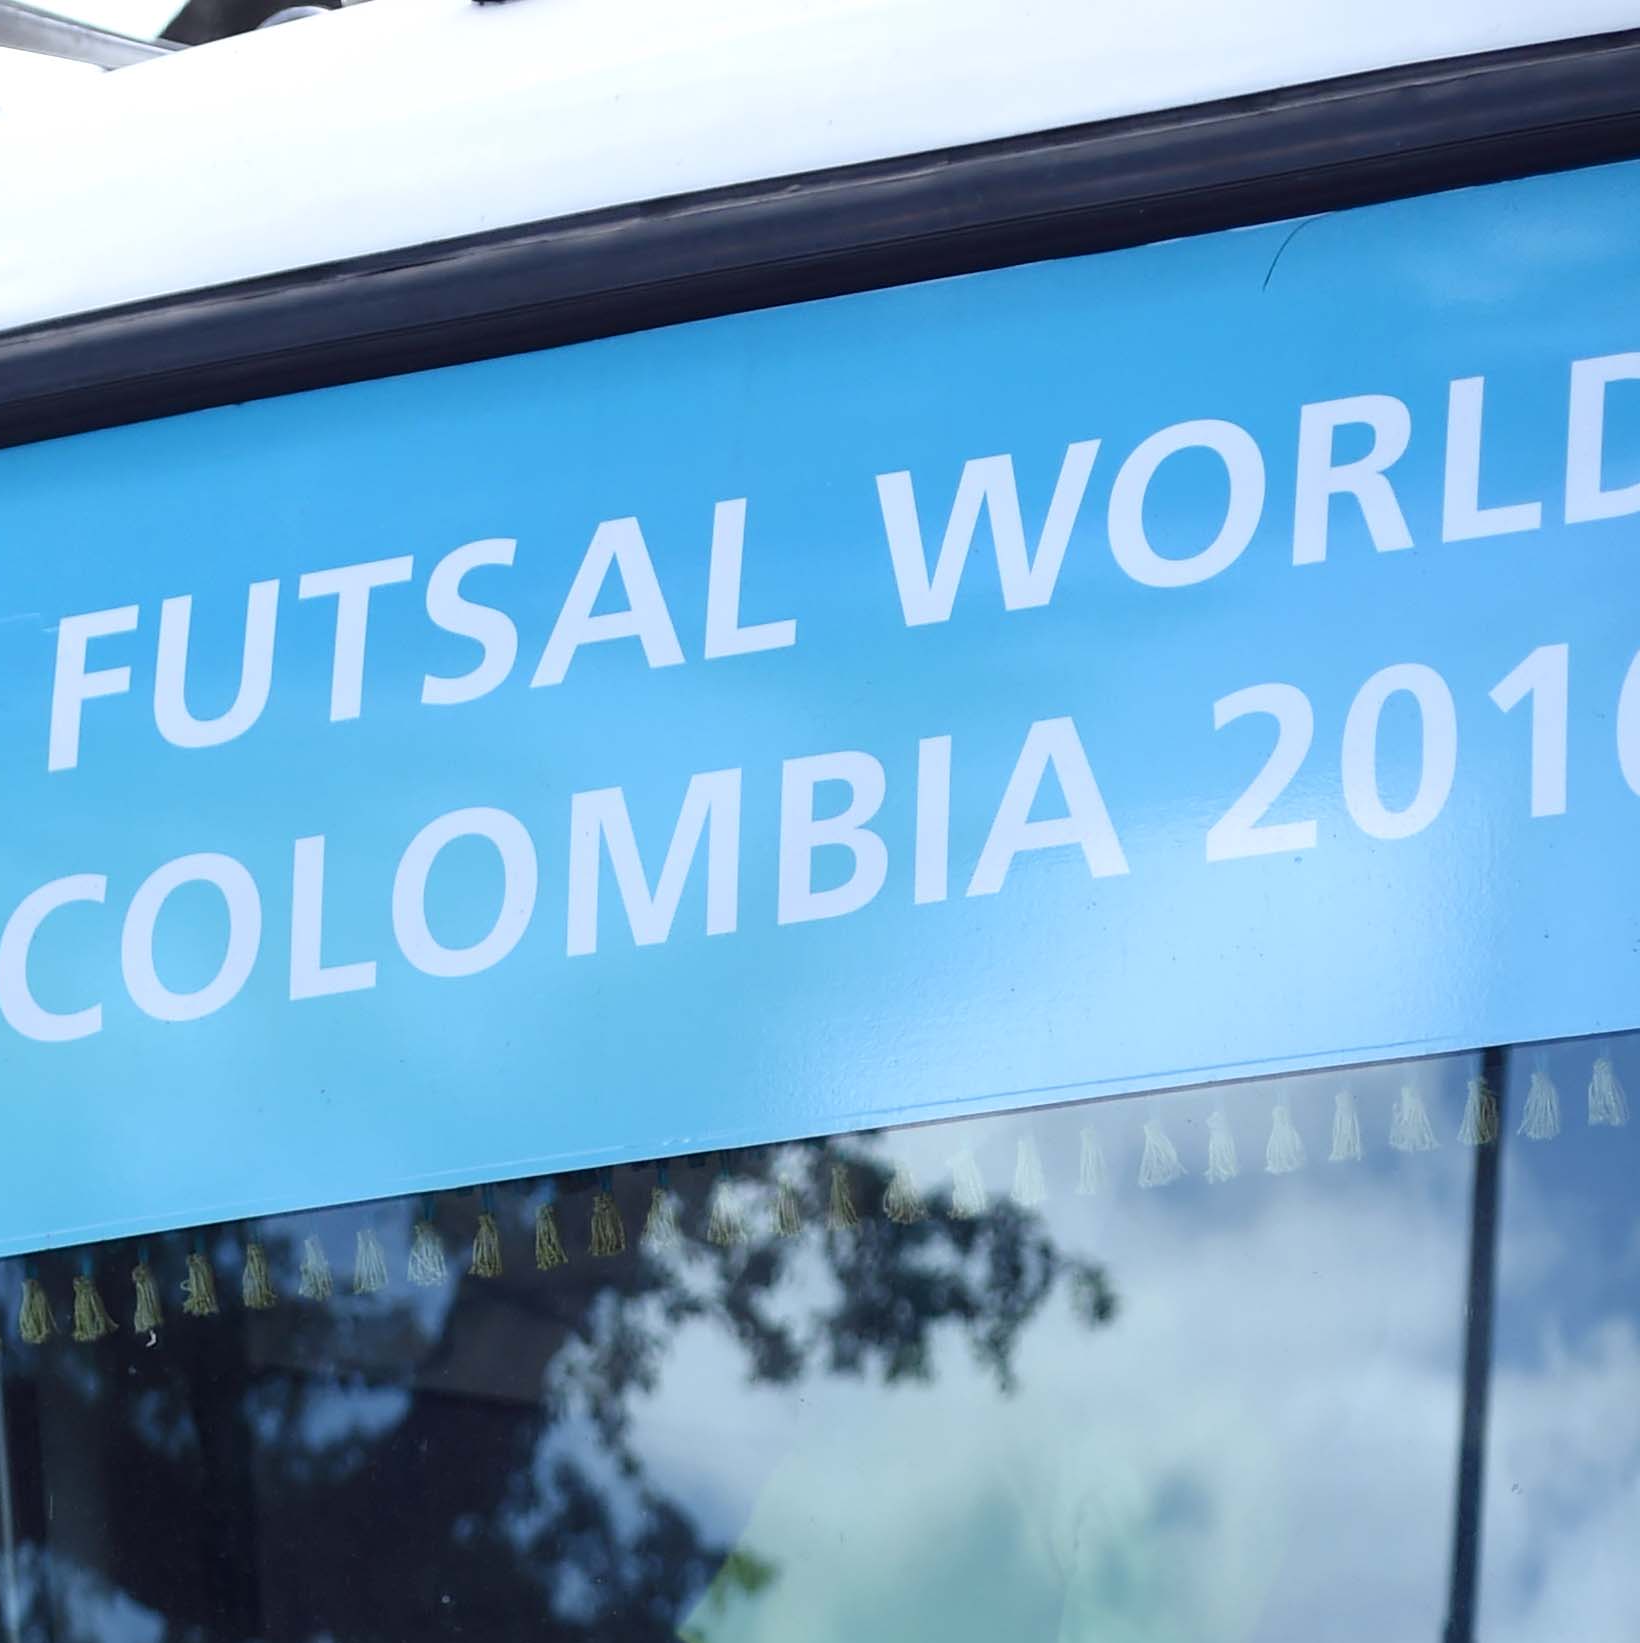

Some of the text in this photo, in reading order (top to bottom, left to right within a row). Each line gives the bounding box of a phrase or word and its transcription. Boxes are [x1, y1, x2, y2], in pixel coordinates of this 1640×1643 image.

[47, 497, 797, 771] FUTSAL
[874, 351, 1640, 628] WORLD
[1205, 643, 1640, 862] 201
